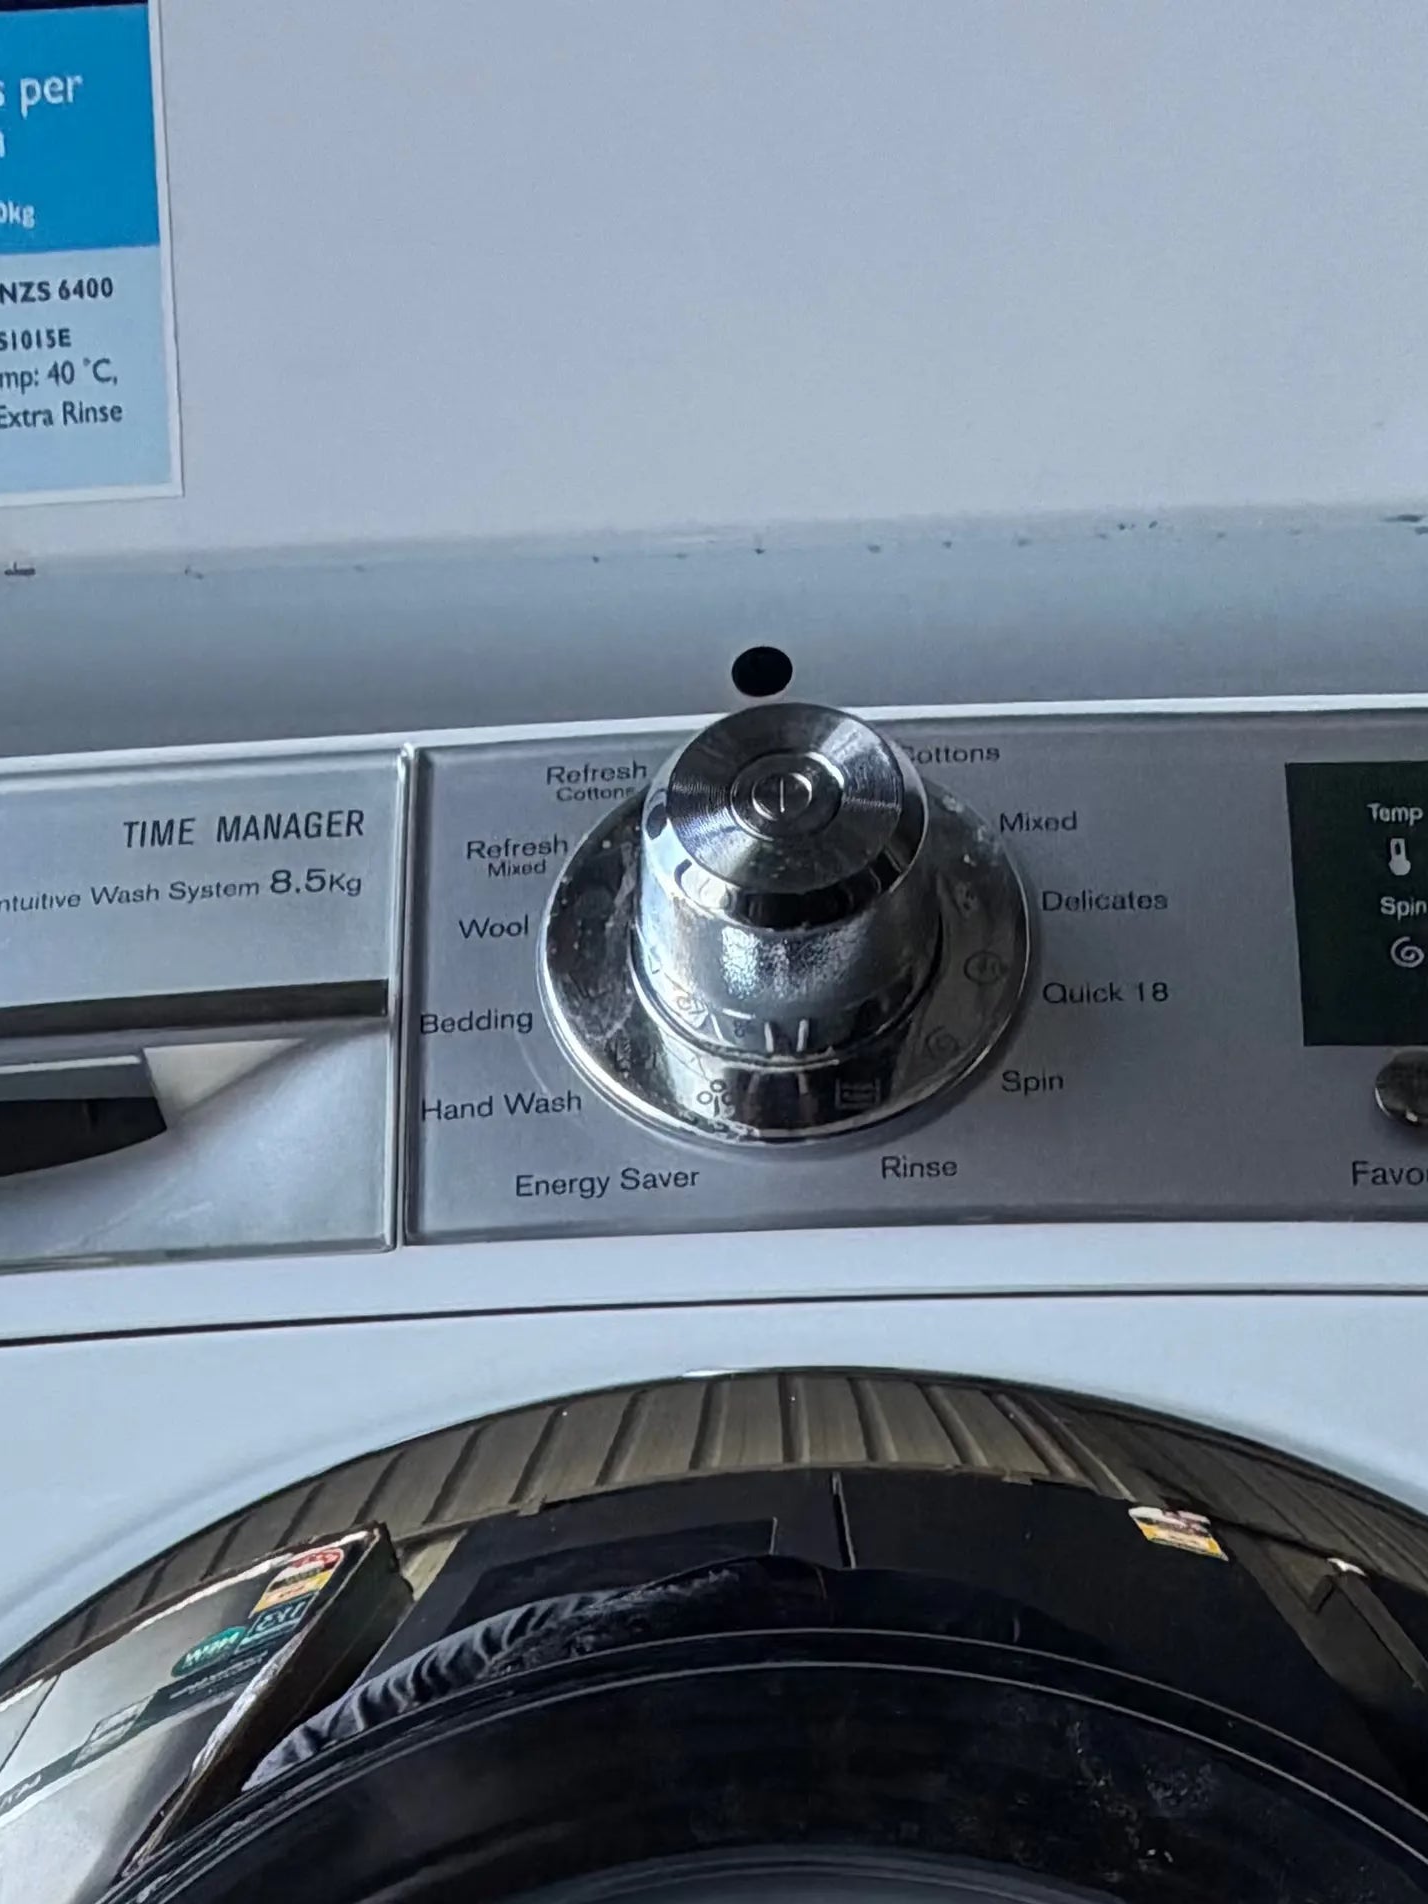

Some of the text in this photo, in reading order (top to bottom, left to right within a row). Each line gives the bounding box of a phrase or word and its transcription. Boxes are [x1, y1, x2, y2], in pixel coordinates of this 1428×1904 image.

[20, 72, 83, 119] per
[57, 277, 113, 302] 6400
[47, 360, 75, 386] 40
[62, 399, 123, 426] Rinse
[546, 760, 648, 785] Refresh
[999, 810, 1078, 834] Mixed
[1367, 802, 1424, 827] Temp
[123, 809, 365, 849] TIME MANAGER
[466, 833, 569, 860] Refresh
[488, 858, 547, 878] Mixed
[90, 884, 160, 906] Wash
[169, 880, 260, 904] System
[270, 868, 363, 898] 8.5Kg
[1041, 890, 1169, 912] Delicates
[1379, 896, 1428, 922] Spin
[458, 914, 529, 942] Wool
[1042, 981, 1170, 1006] Quick 18
[419, 1007, 534, 1035] Bedding
[1000, 1068, 1065, 1098] Spin
[420, 1089, 582, 1121] Hand Wash
[880, 1154, 959, 1180] Rinse
[515, 1166, 700, 1200] Energy Saver
